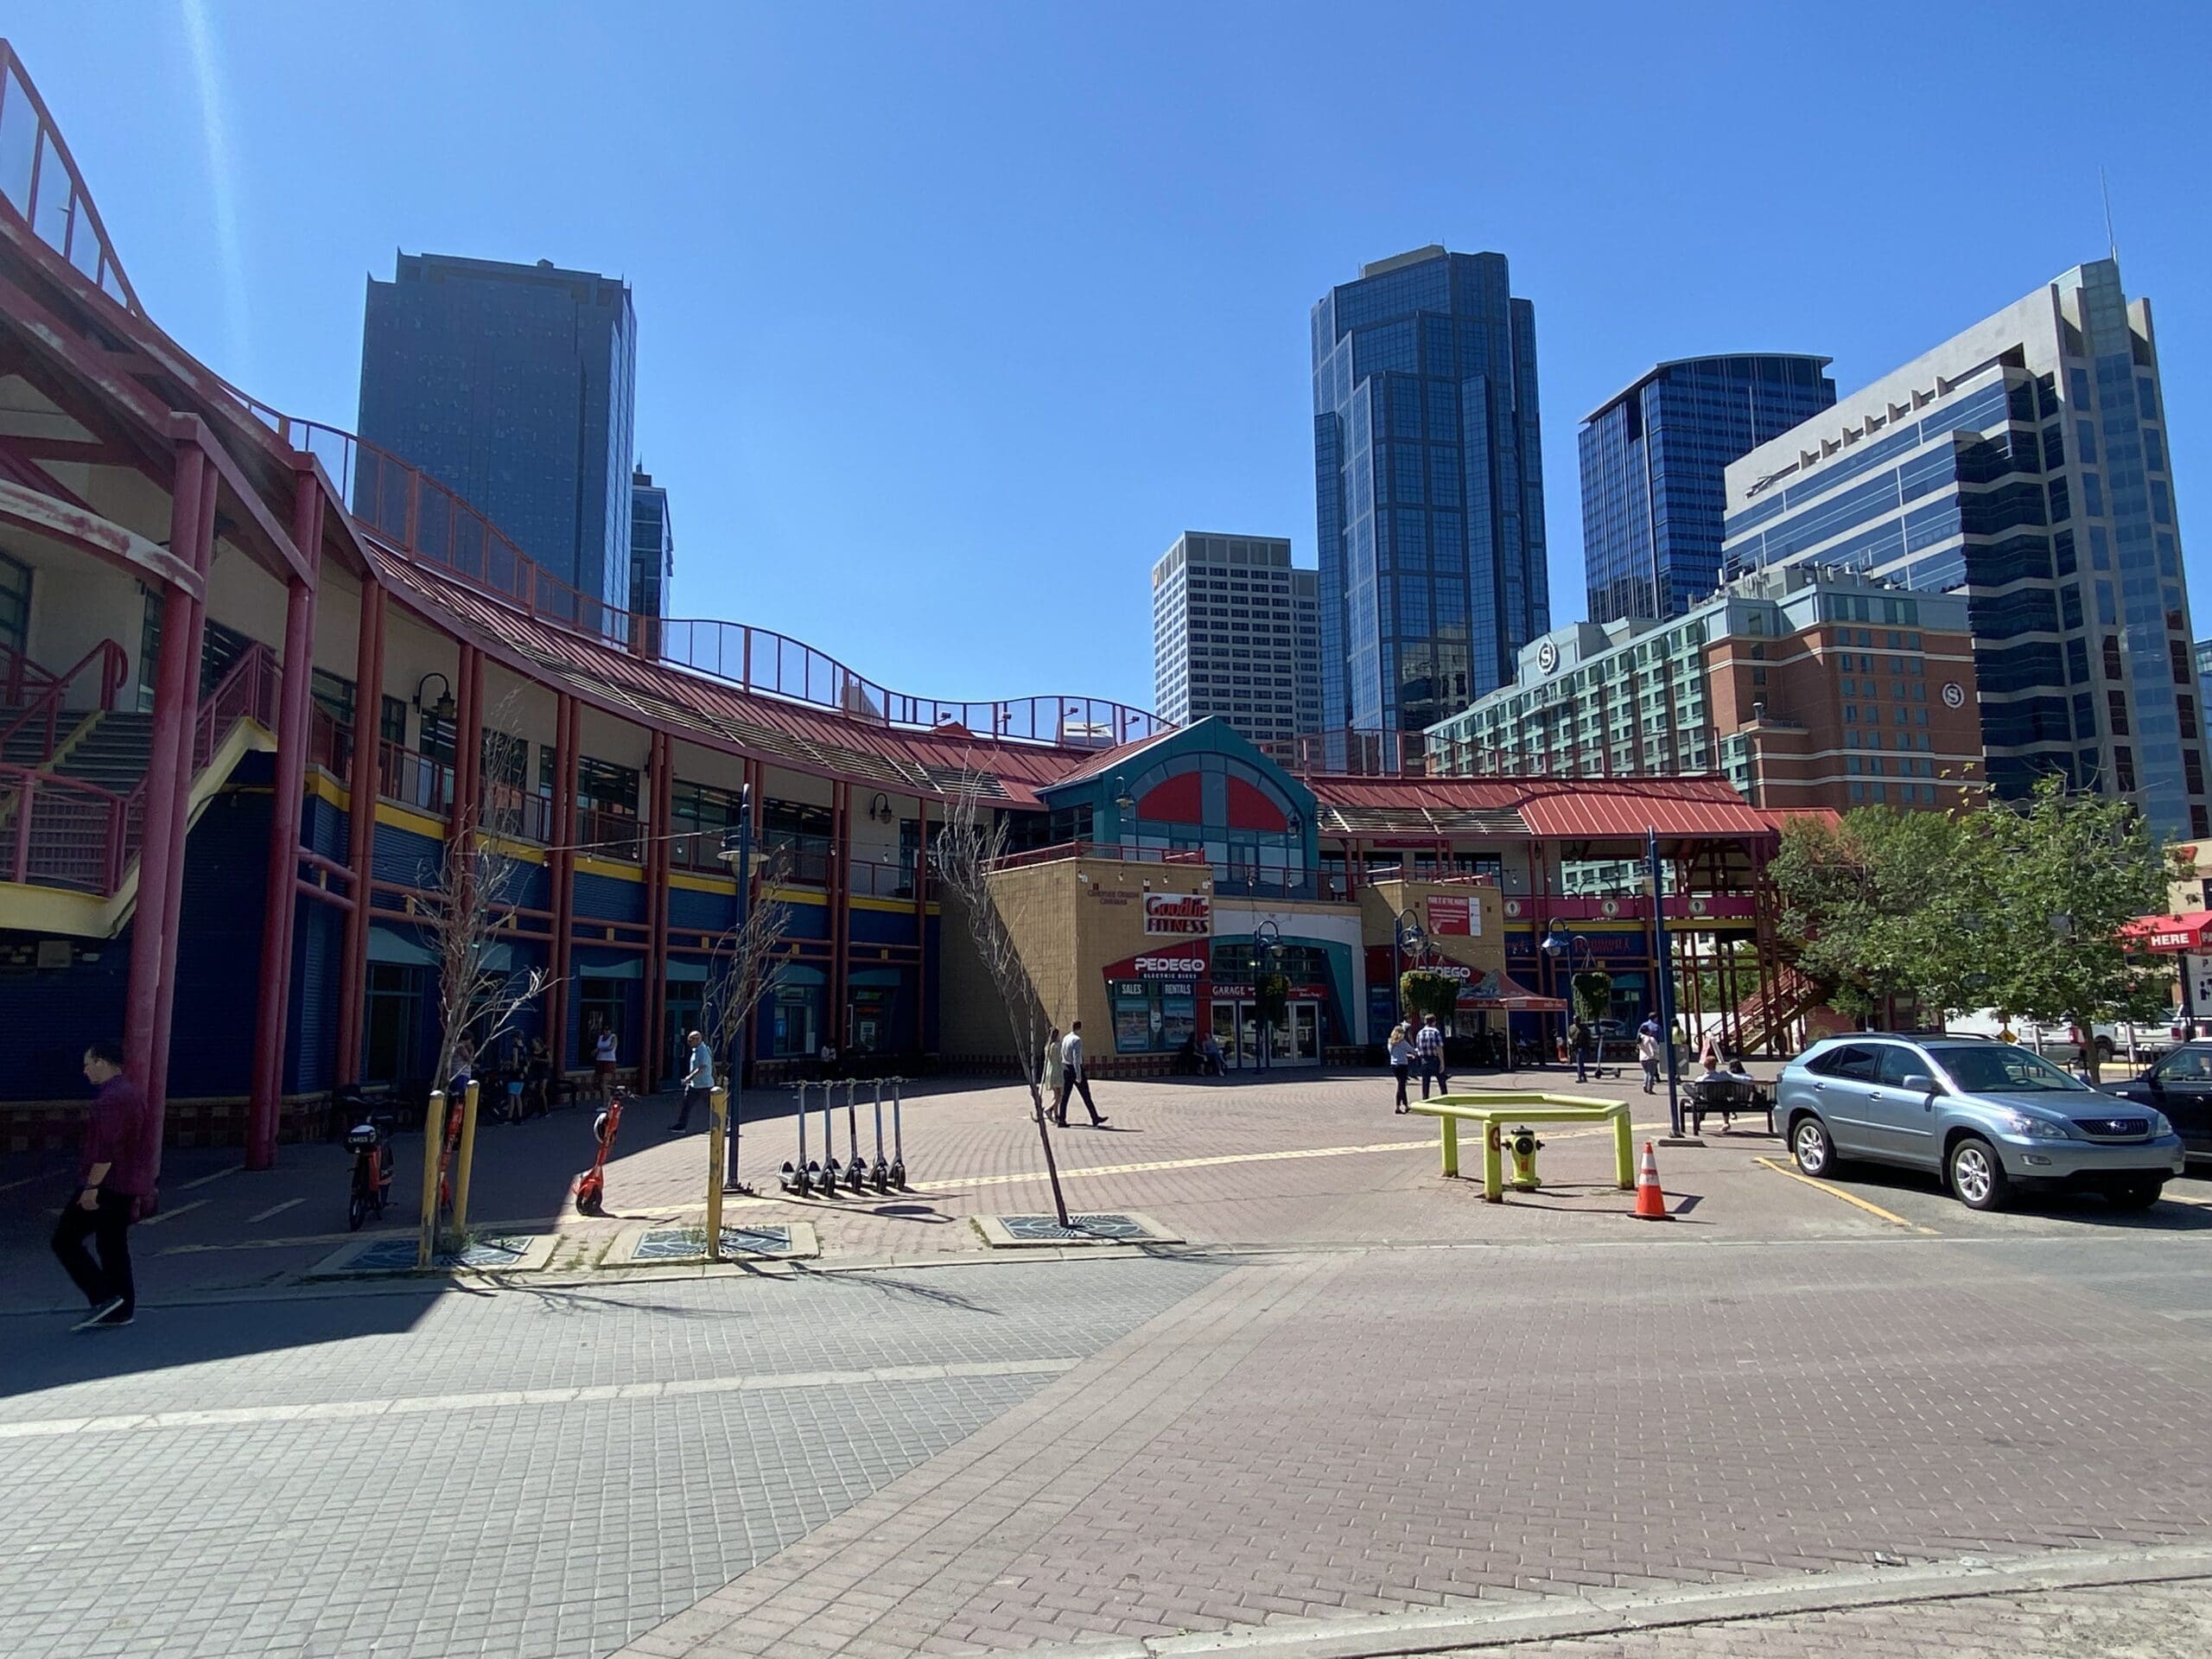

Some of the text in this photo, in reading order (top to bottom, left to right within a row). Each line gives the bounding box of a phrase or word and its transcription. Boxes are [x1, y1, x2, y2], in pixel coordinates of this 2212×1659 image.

[1147, 918, 1210, 933] FITNESS
[2151, 932, 2190, 946] HERE
[1135, 957, 1205, 971] PEDEGO
[1122, 983, 1142, 995] SALES
[1164, 983, 1192, 995] RENTALS
[1212, 985, 1245, 995] GARAGE
